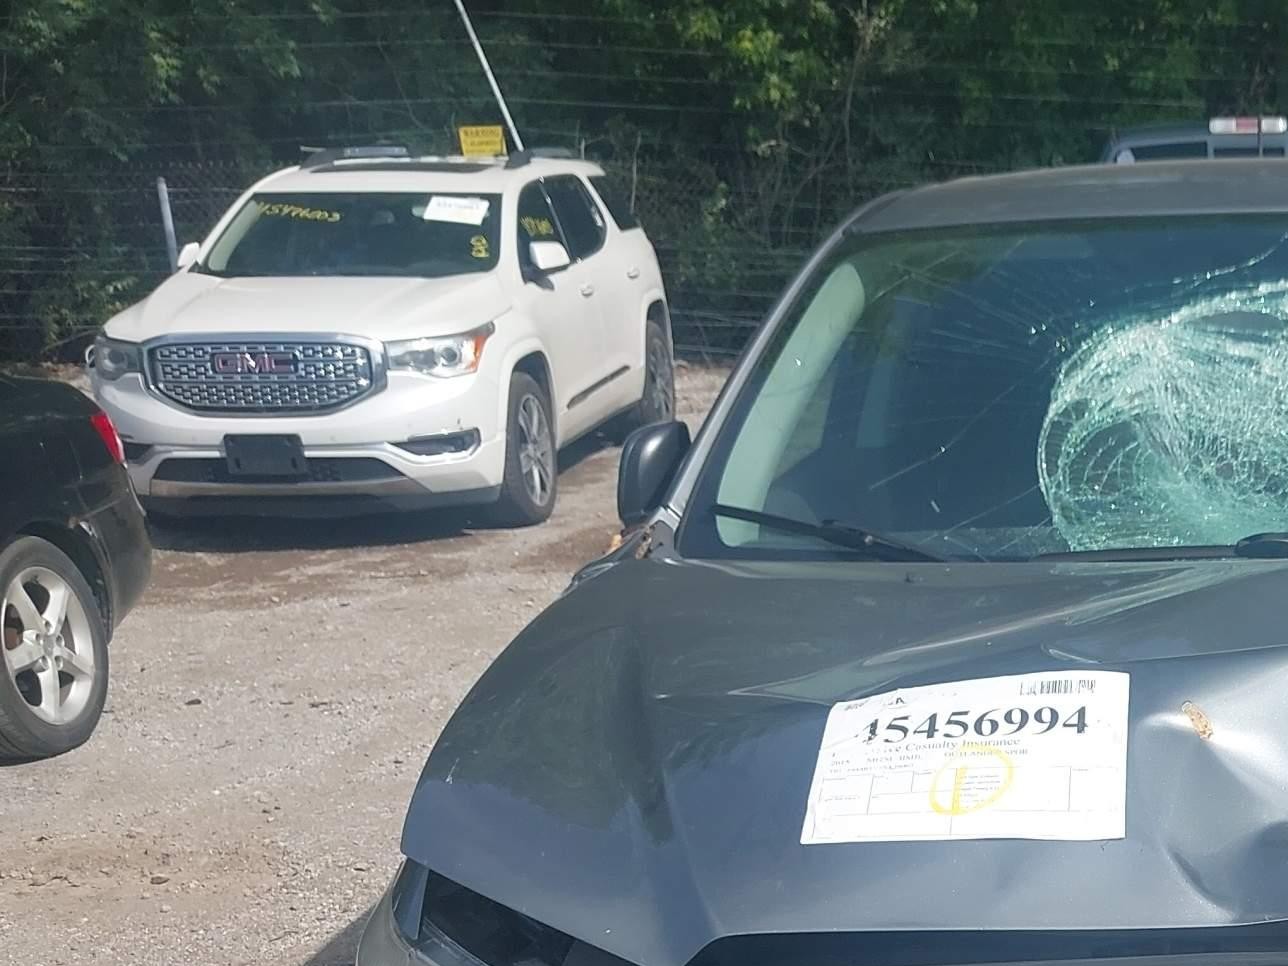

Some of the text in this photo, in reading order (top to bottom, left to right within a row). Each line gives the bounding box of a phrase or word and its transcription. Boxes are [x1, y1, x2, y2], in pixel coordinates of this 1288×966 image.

[215, 353, 294, 374] GMC
[905, 740, 958, 752] Casualty
[962, 738, 1021, 748] Insurance
